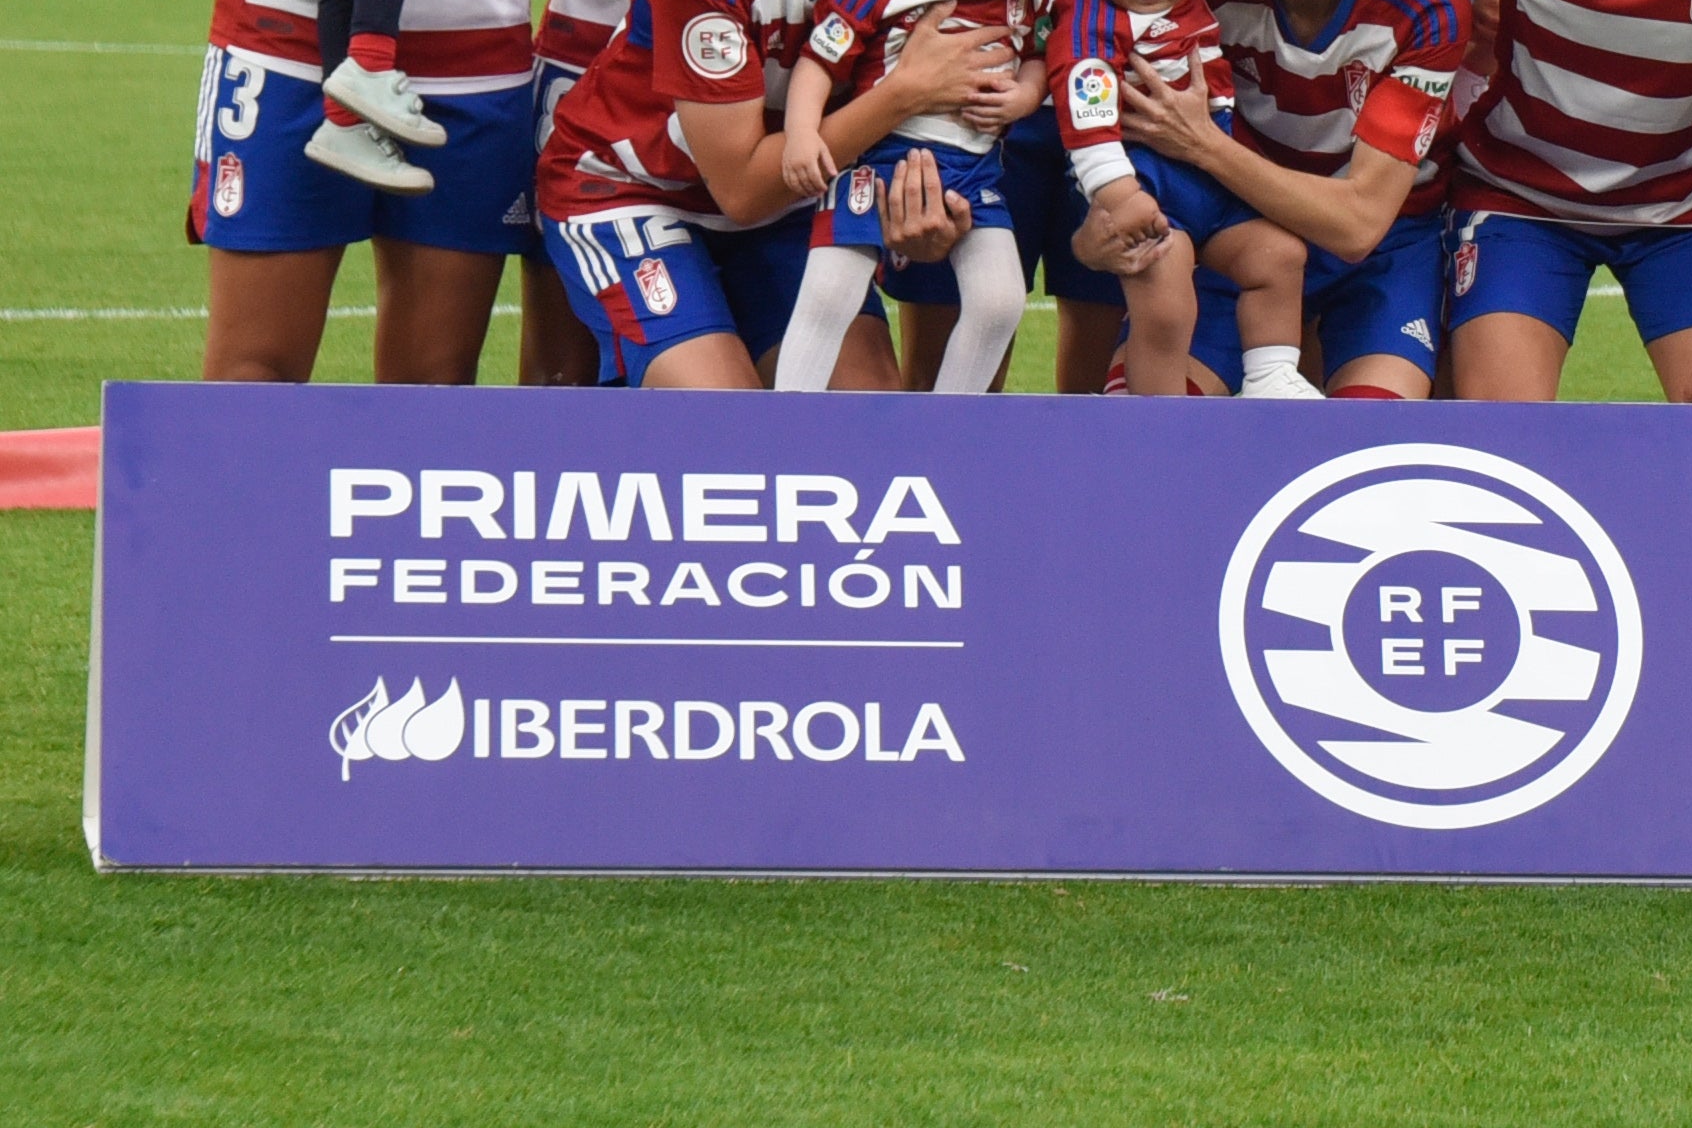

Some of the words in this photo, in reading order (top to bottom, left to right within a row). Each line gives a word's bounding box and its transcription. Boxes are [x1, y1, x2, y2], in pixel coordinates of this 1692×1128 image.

[1077, 107, 1114, 119] LaLiga
[329, 468, 962, 545] PRIMERA
[329, 548, 962, 609] FEDERACIÓN
[473, 698, 966, 762] IBERDROLA
